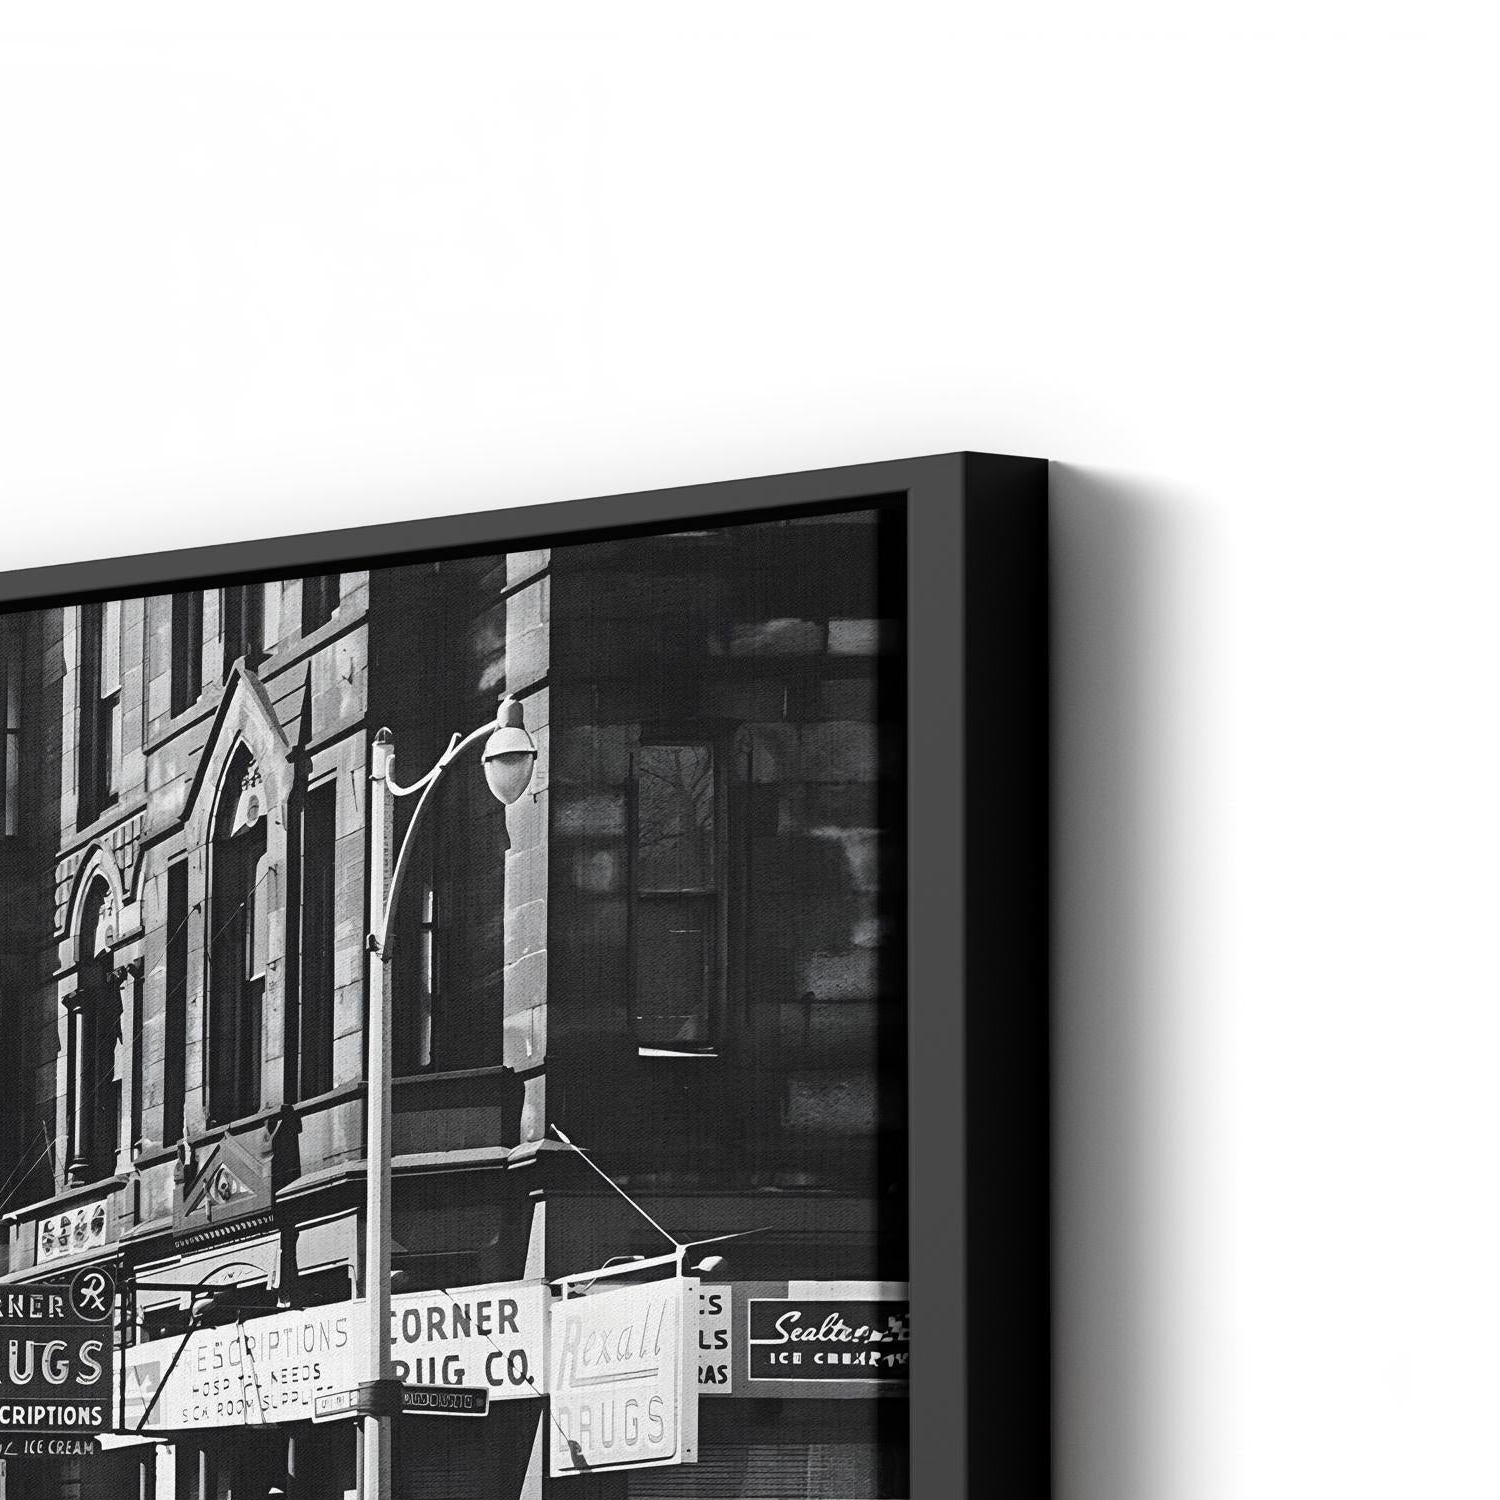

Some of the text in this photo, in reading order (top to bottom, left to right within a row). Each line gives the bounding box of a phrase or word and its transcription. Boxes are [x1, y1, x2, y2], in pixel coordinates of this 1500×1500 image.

[485, 1349, 535, 1386] CO.
[556, 1298, 668, 1391] Rexall
[24, 1439, 44, 1455] ICE
[559, 1395, 664, 1453] DRUGS
